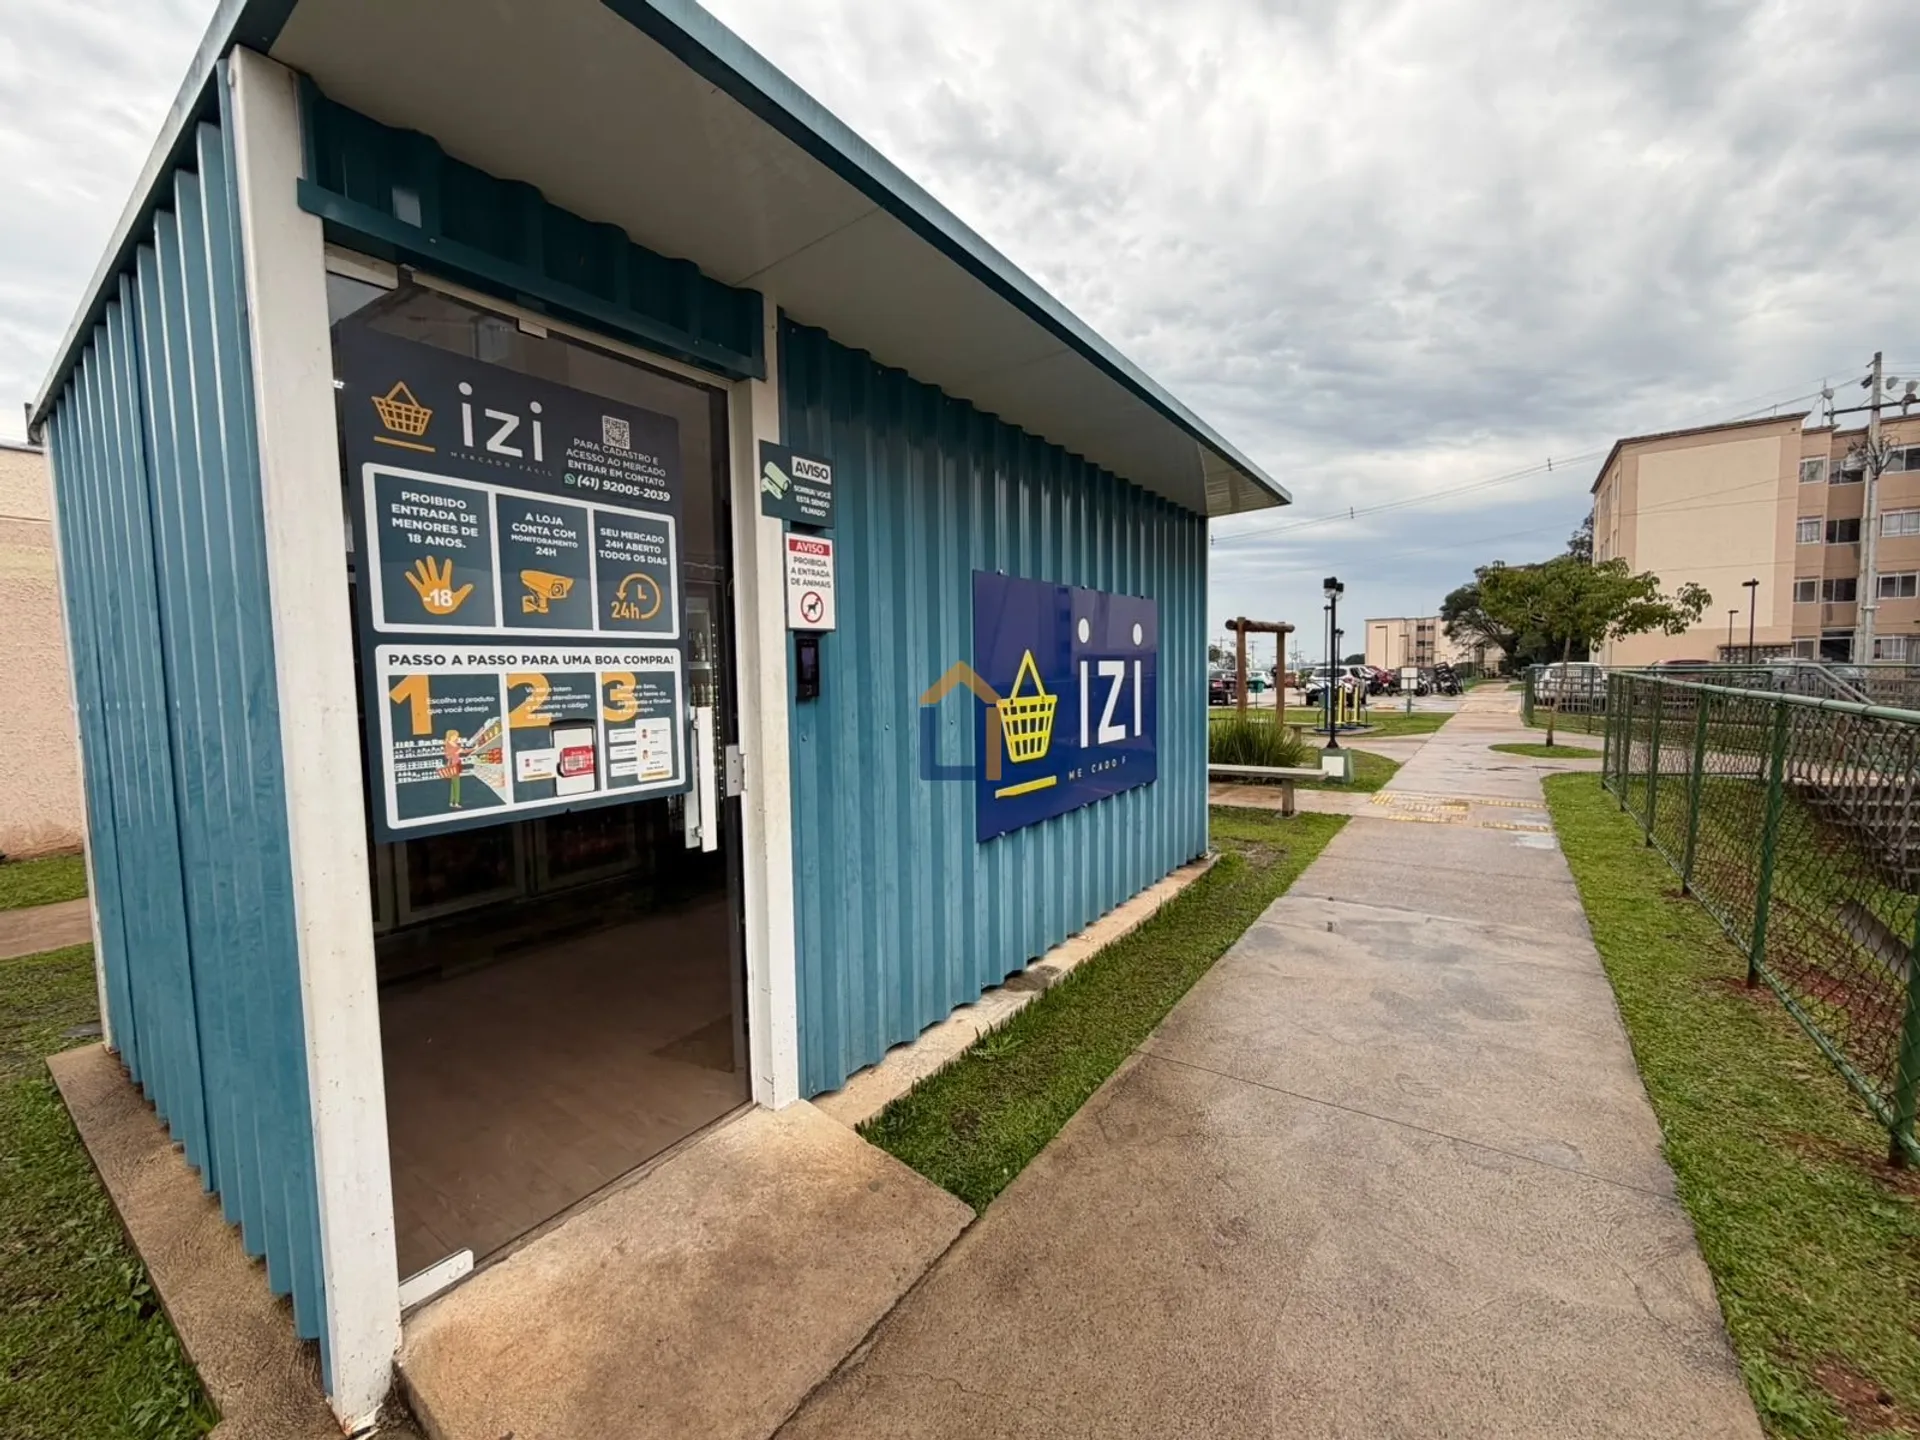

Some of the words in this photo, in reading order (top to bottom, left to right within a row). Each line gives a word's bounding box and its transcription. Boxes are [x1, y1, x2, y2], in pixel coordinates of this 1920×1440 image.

[458, 382, 543, 462] izi
[450, 451, 511, 468] MERCADO
[573, 437, 600, 451] PARA
[602, 445, 651, 463] CADASTRO
[652, 457, 659, 466] E
[566, 448, 604, 463] ACESSO
[607, 457, 621, 467] AO
[622, 461, 666, 477] MERCADO
[795, 462, 829, 480] AVISO
[567, 459, 607, 475] ENTRAR
[609, 468, 623, 479] EM
[624, 472, 665, 487] CONTATO
[577, 474, 600, 490] (41)
[602, 480, 671, 502] 92005-2039
[401, 491, 467, 509] PROIBIDO
[811, 498, 830, 508] SENDO
[391, 503, 457, 521] ENTRADA
[460, 513, 478, 524] DE
[525, 512, 534, 521] A
[536, 514, 564, 526] LOJA
[801, 505, 827, 517] FILMADO
[392, 517, 458, 535] MENORES
[461, 527, 479, 537] DE
[511, 523, 550, 536] CONTA
[552, 528, 577, 540] COM
[600, 527, 619, 537] SEU
[620, 530, 665, 544] MERCADO
[407, 533, 422, 543] 18
[425, 536, 467, 549] ANOS.
[511, 534, 579, 549] MONITORAMENTO
[605, 539, 624, 549] 24H
[625, 543, 661, 554] ABERTO
[796, 542, 824, 554] AVISO
[535, 546, 557, 557] 24H
[599, 550, 631, 561] TODOS
[633, 554, 646, 563] OS
[647, 557, 668, 566] DIAS
[793, 556, 827, 567] PROIBIDA
[798, 567, 830, 577] ENTRADA
[803, 579, 831, 588] ANIMAIS
[423, 588, 453, 607] -18
[611, 601, 640, 619] 24h
[388, 654, 447, 666] PASSO
[451, 655, 463, 666] A
[467, 654, 518, 666] PASSO
[521, 655, 559, 665] PARA
[562, 656, 592, 665] UMA
[595, 656, 621, 665] BOA
[624, 655, 674, 665] COMPRA!
[388, 673, 433, 735] 1
[465, 695, 495, 704] produto
[507, 672, 552, 729] 2
[602, 671, 637, 722] 3
[464, 704, 489, 714] deseja
